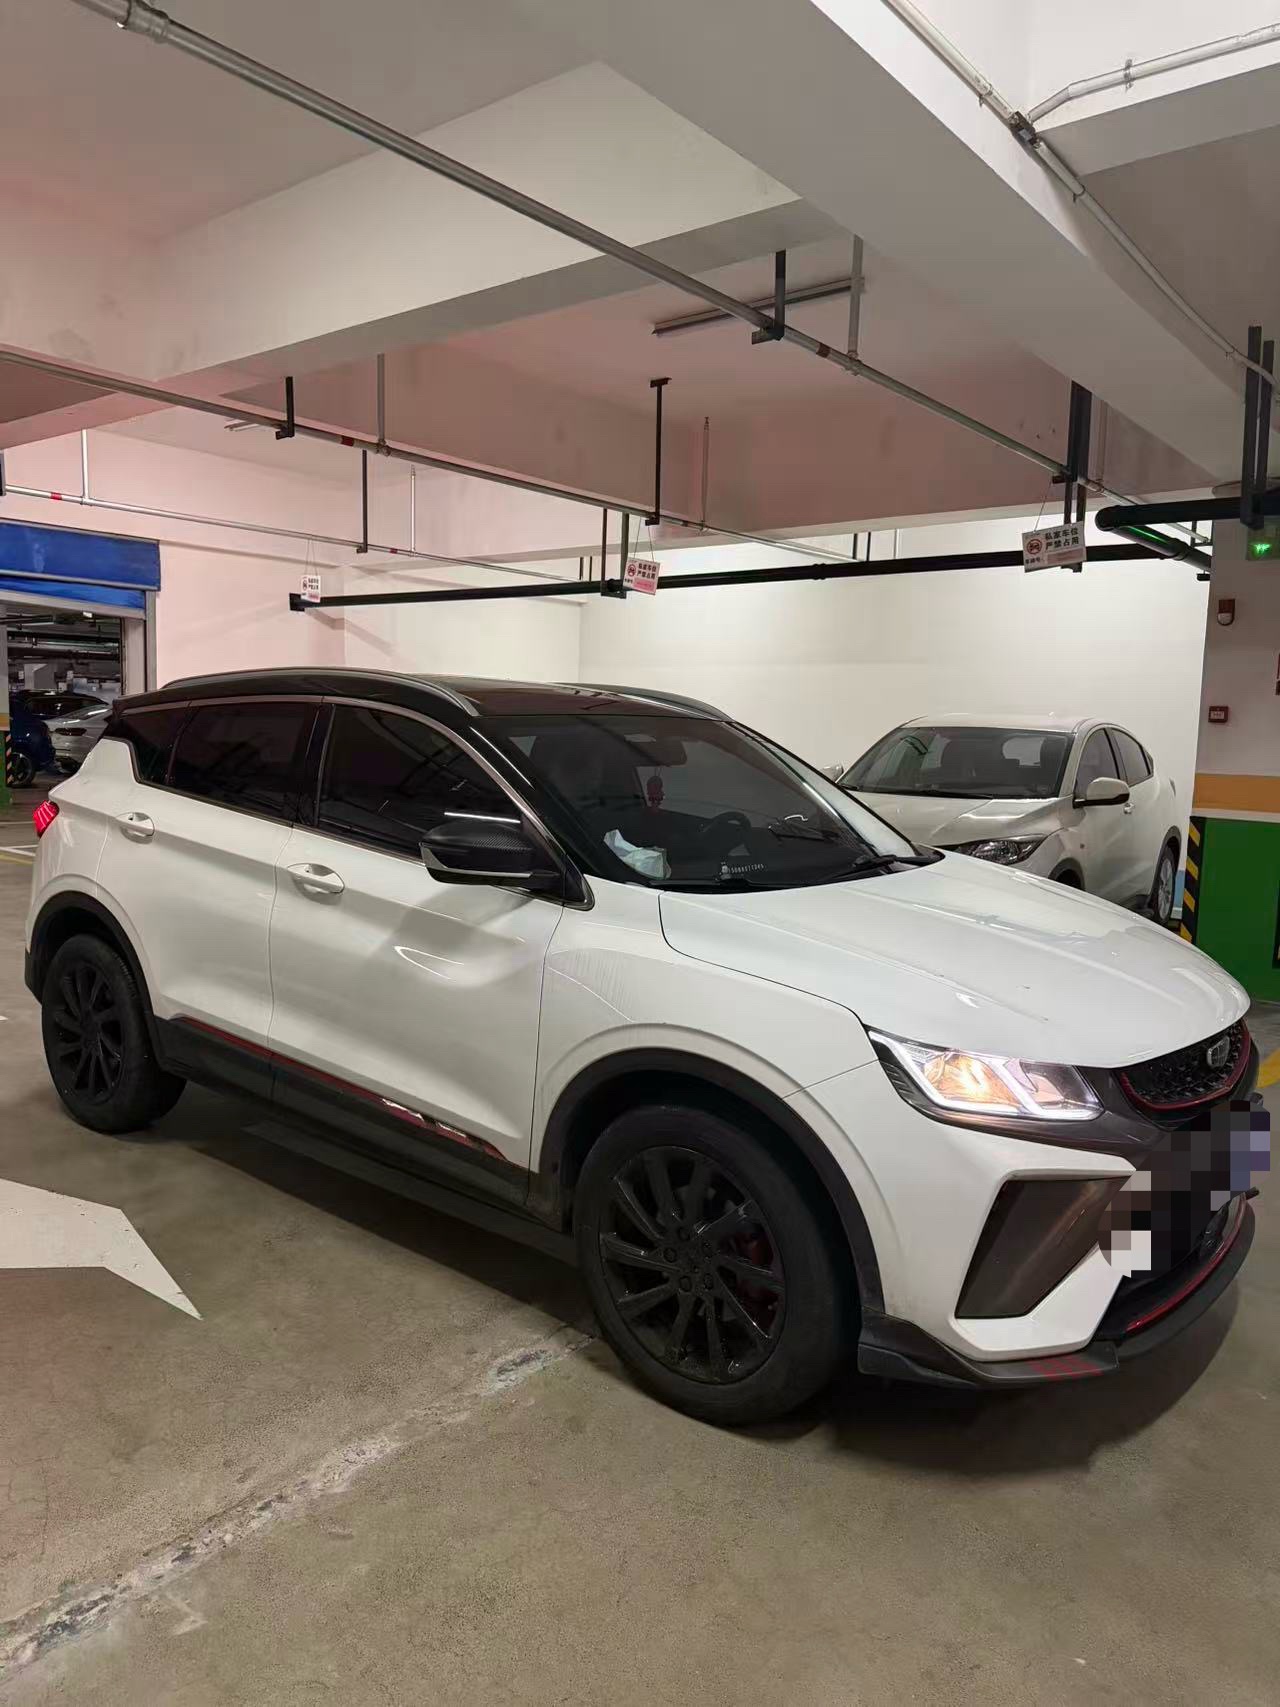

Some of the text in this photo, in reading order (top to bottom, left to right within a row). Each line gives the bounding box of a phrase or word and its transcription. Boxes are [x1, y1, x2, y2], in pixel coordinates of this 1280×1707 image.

[1045, 527, 1079, 540] 私家车位
[1045, 536, 1079, 550] 严禁占用
